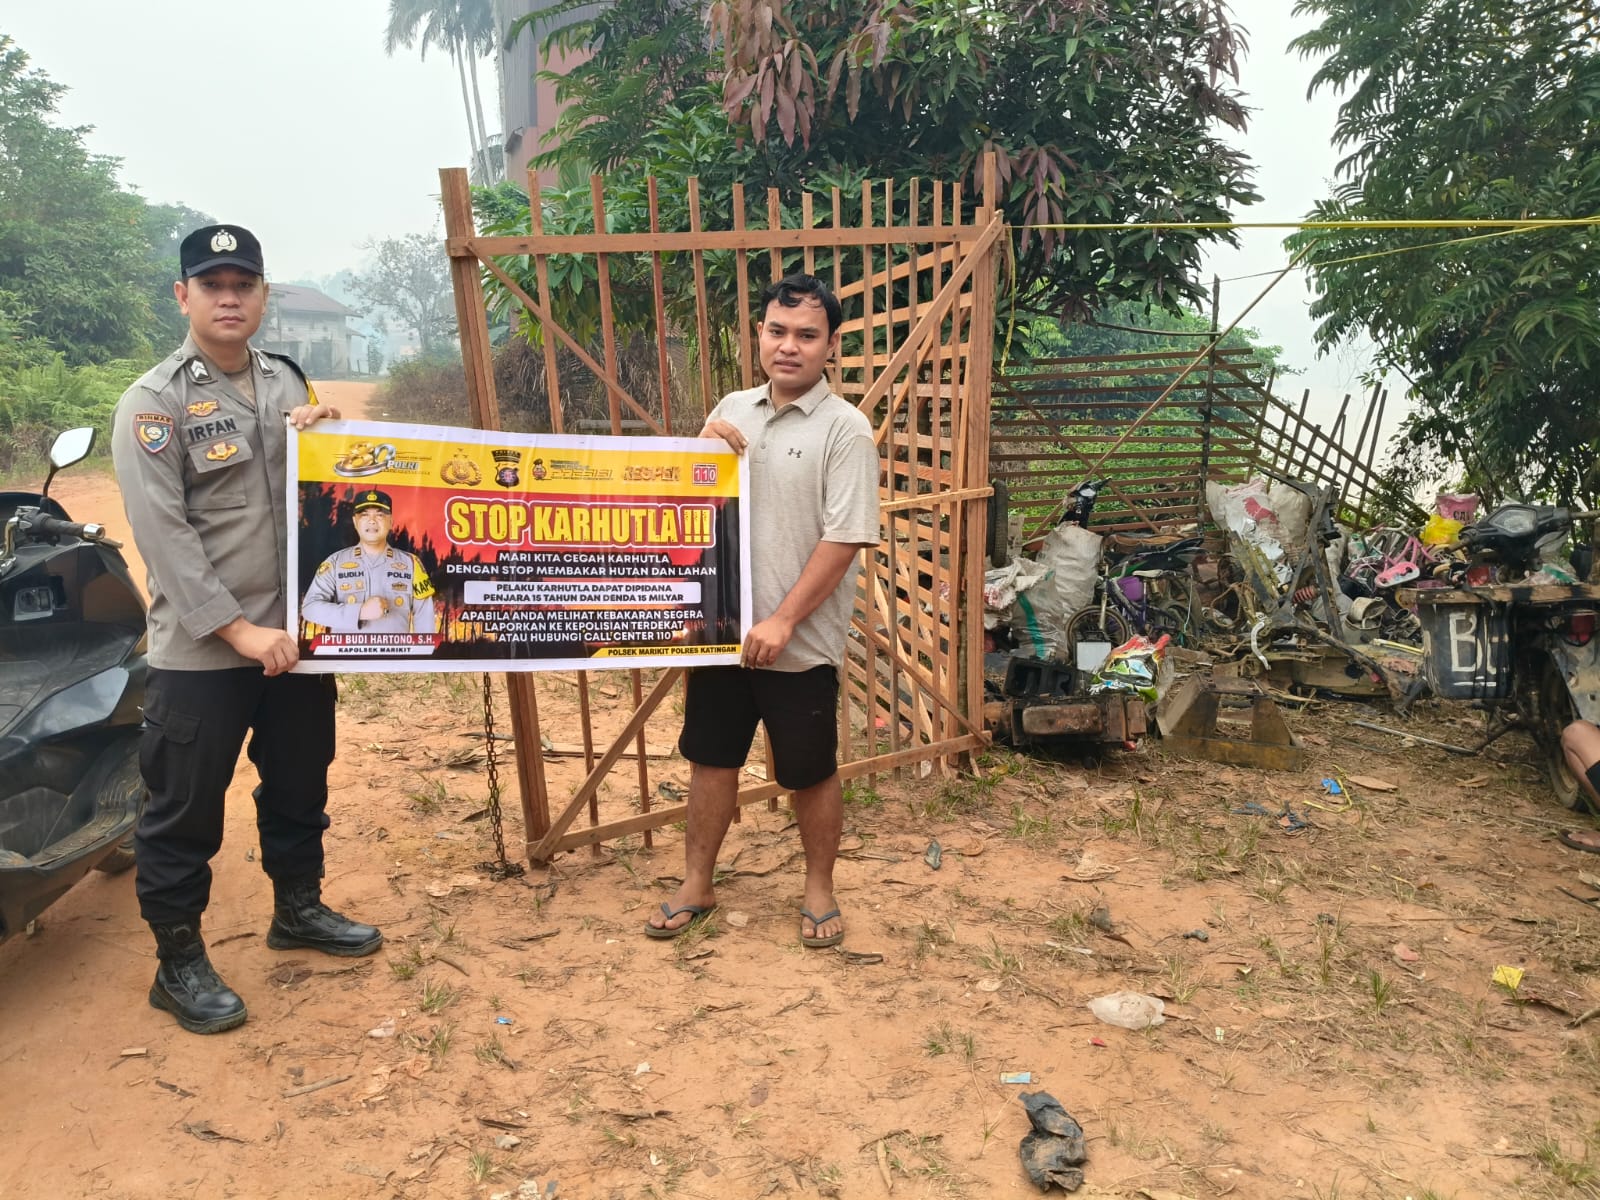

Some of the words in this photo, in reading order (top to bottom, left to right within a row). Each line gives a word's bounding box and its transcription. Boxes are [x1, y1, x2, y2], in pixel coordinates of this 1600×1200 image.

[188, 418, 237, 442] IRFAN
[623, 466, 681, 481] RESPEK
[695, 468, 716, 482] 110
[451, 501, 527, 540] STOP
[534, 506, 678, 543] KARHUTLA
[683, 509, 712, 543] !!!
[499, 552, 531, 562] MARI
[534, 553, 561, 563] KITA
[563, 553, 605, 563] CEGAH
[608, 554, 670, 563] KARHUTLA
[387, 571, 412, 580] POLRI
[446, 564, 499, 574] DENGAN
[501, 565, 534, 575] STOP
[536, 566, 606, 576] MEMBAKAR
[609, 567, 649, 576] HUTAN
[651, 567, 676, 576] DAN
[678, 567, 717, 576] LAHAN
[496, 584, 535, 592] PELAKU
[537, 584, 589, 592] KARHUTLA
[592, 584, 624, 592] DAPAT
[625, 584, 672, 592] DIPIDANA
[483, 594, 530, 602] PENJARA
[532, 594, 541, 602] 15
[544, 594, 578, 602] TAHUN
[580, 594, 601, 602] DAN
[602, 594, 636, 602] DENDA
[638, 594, 647, 602] 15
[649, 594, 684, 602] MILYAR
[461, 611, 510, 621] APABILA
[512, 611, 545, 621] ANDA
[547, 611, 595, 621] MELIHAT
[597, 610, 661, 620] KEBAKARAN
[663, 610, 704, 619] SEGERA
[485, 622, 547, 632] LAPORKAN
[549, 622, 563, 631] KE
[565, 621, 629, 631] KEPOLISIAN
[631, 620, 684, 630] TERDEKAT
[321, 634, 342, 644] IPTU
[345, 634, 367, 644] BUDI
[370, 634, 416, 646] HARTONO,
[417, 635, 435, 644] S.H.
[498, 633, 528, 642] ATAU
[530, 633, 582, 642] HUBUNGI
[584, 632, 612, 642] CALL
[613, 632, 654, 641] CENTER
[656, 631, 672, 641] 110
[639, 648, 669, 656] MARIKIT
[671, 647, 699, 655] POLRES
[700, 646, 737, 654] KATINGAN
